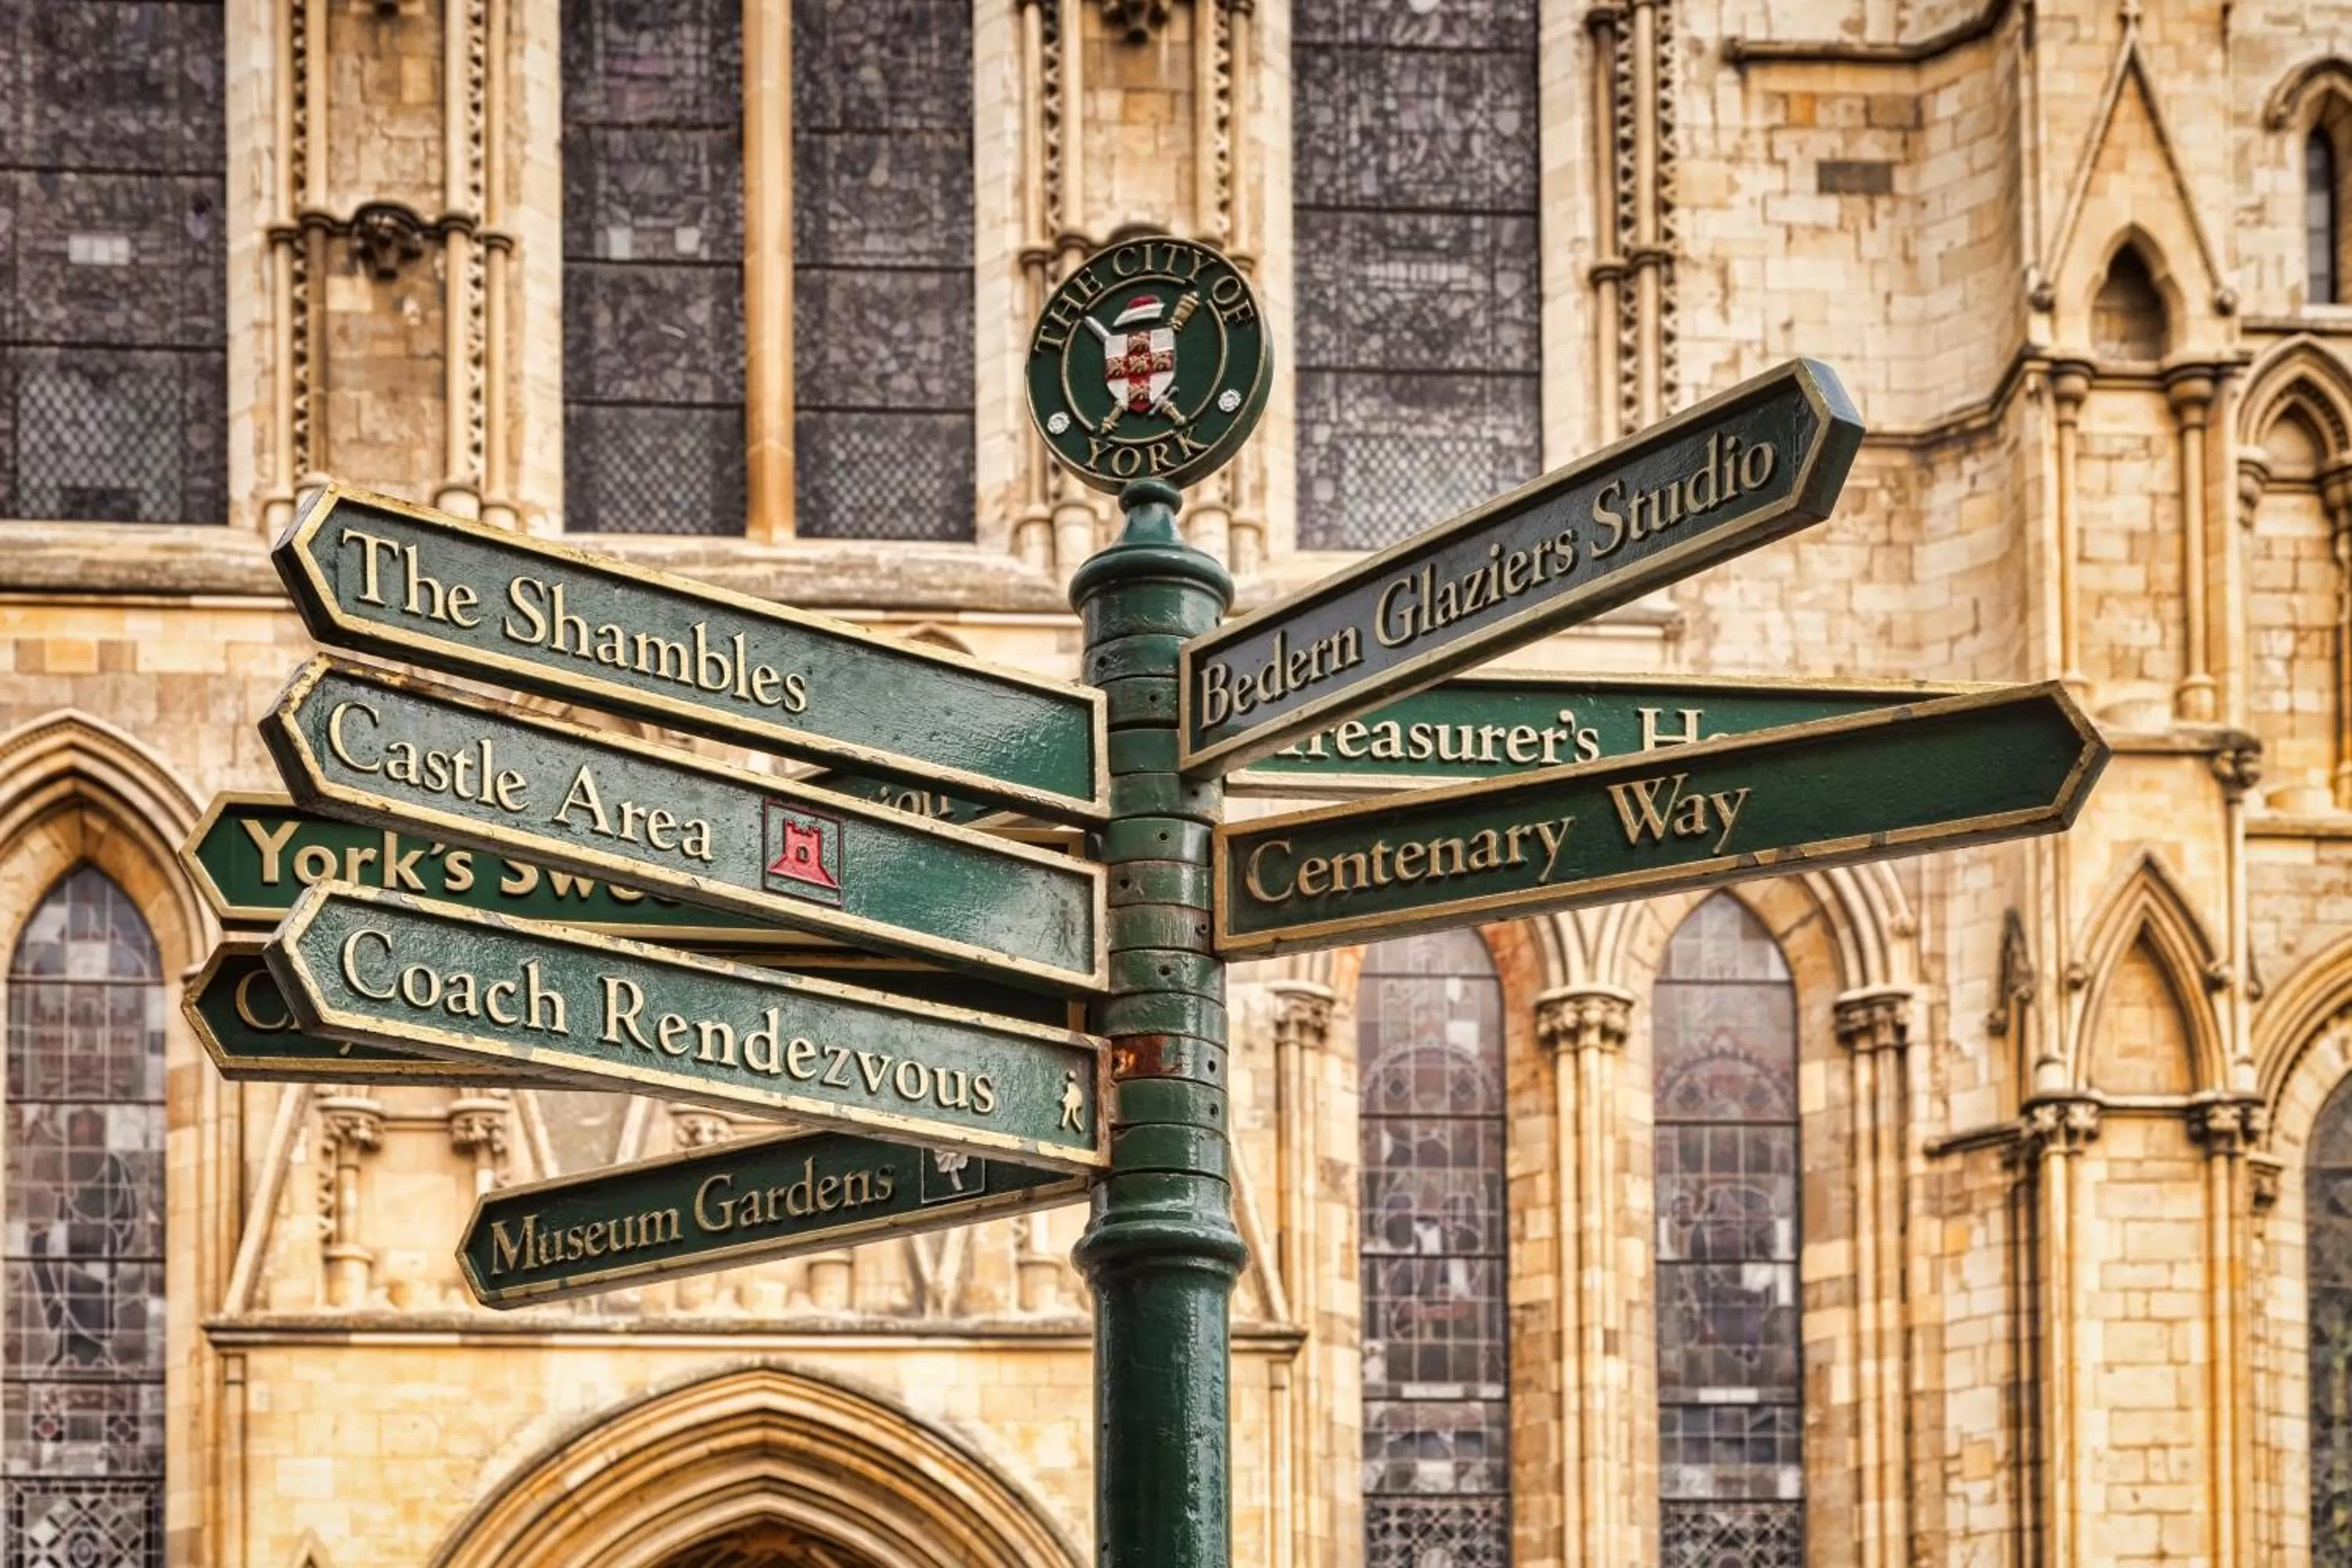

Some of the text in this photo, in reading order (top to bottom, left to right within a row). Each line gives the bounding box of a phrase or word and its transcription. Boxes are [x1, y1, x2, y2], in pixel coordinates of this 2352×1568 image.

[1036, 244, 1254, 355] THE CITY OF
[1084, 427, 1209, 477] YORK
[343, 528, 808, 714] The Shambles
[1200, 433, 1777, 729] Bedern Glaziers Studio
[328, 702, 714, 861] Castle Area
[1276, 708, 1730, 763] reasurer's H
[241, 819, 475, 892] York's
[1245, 772, 1752, 903] Centenary Way
[343, 929, 569, 1036] Coach
[602, 975, 996, 1113] Rendezvous
[489, 1156, 895, 1276] Museum Gardens
